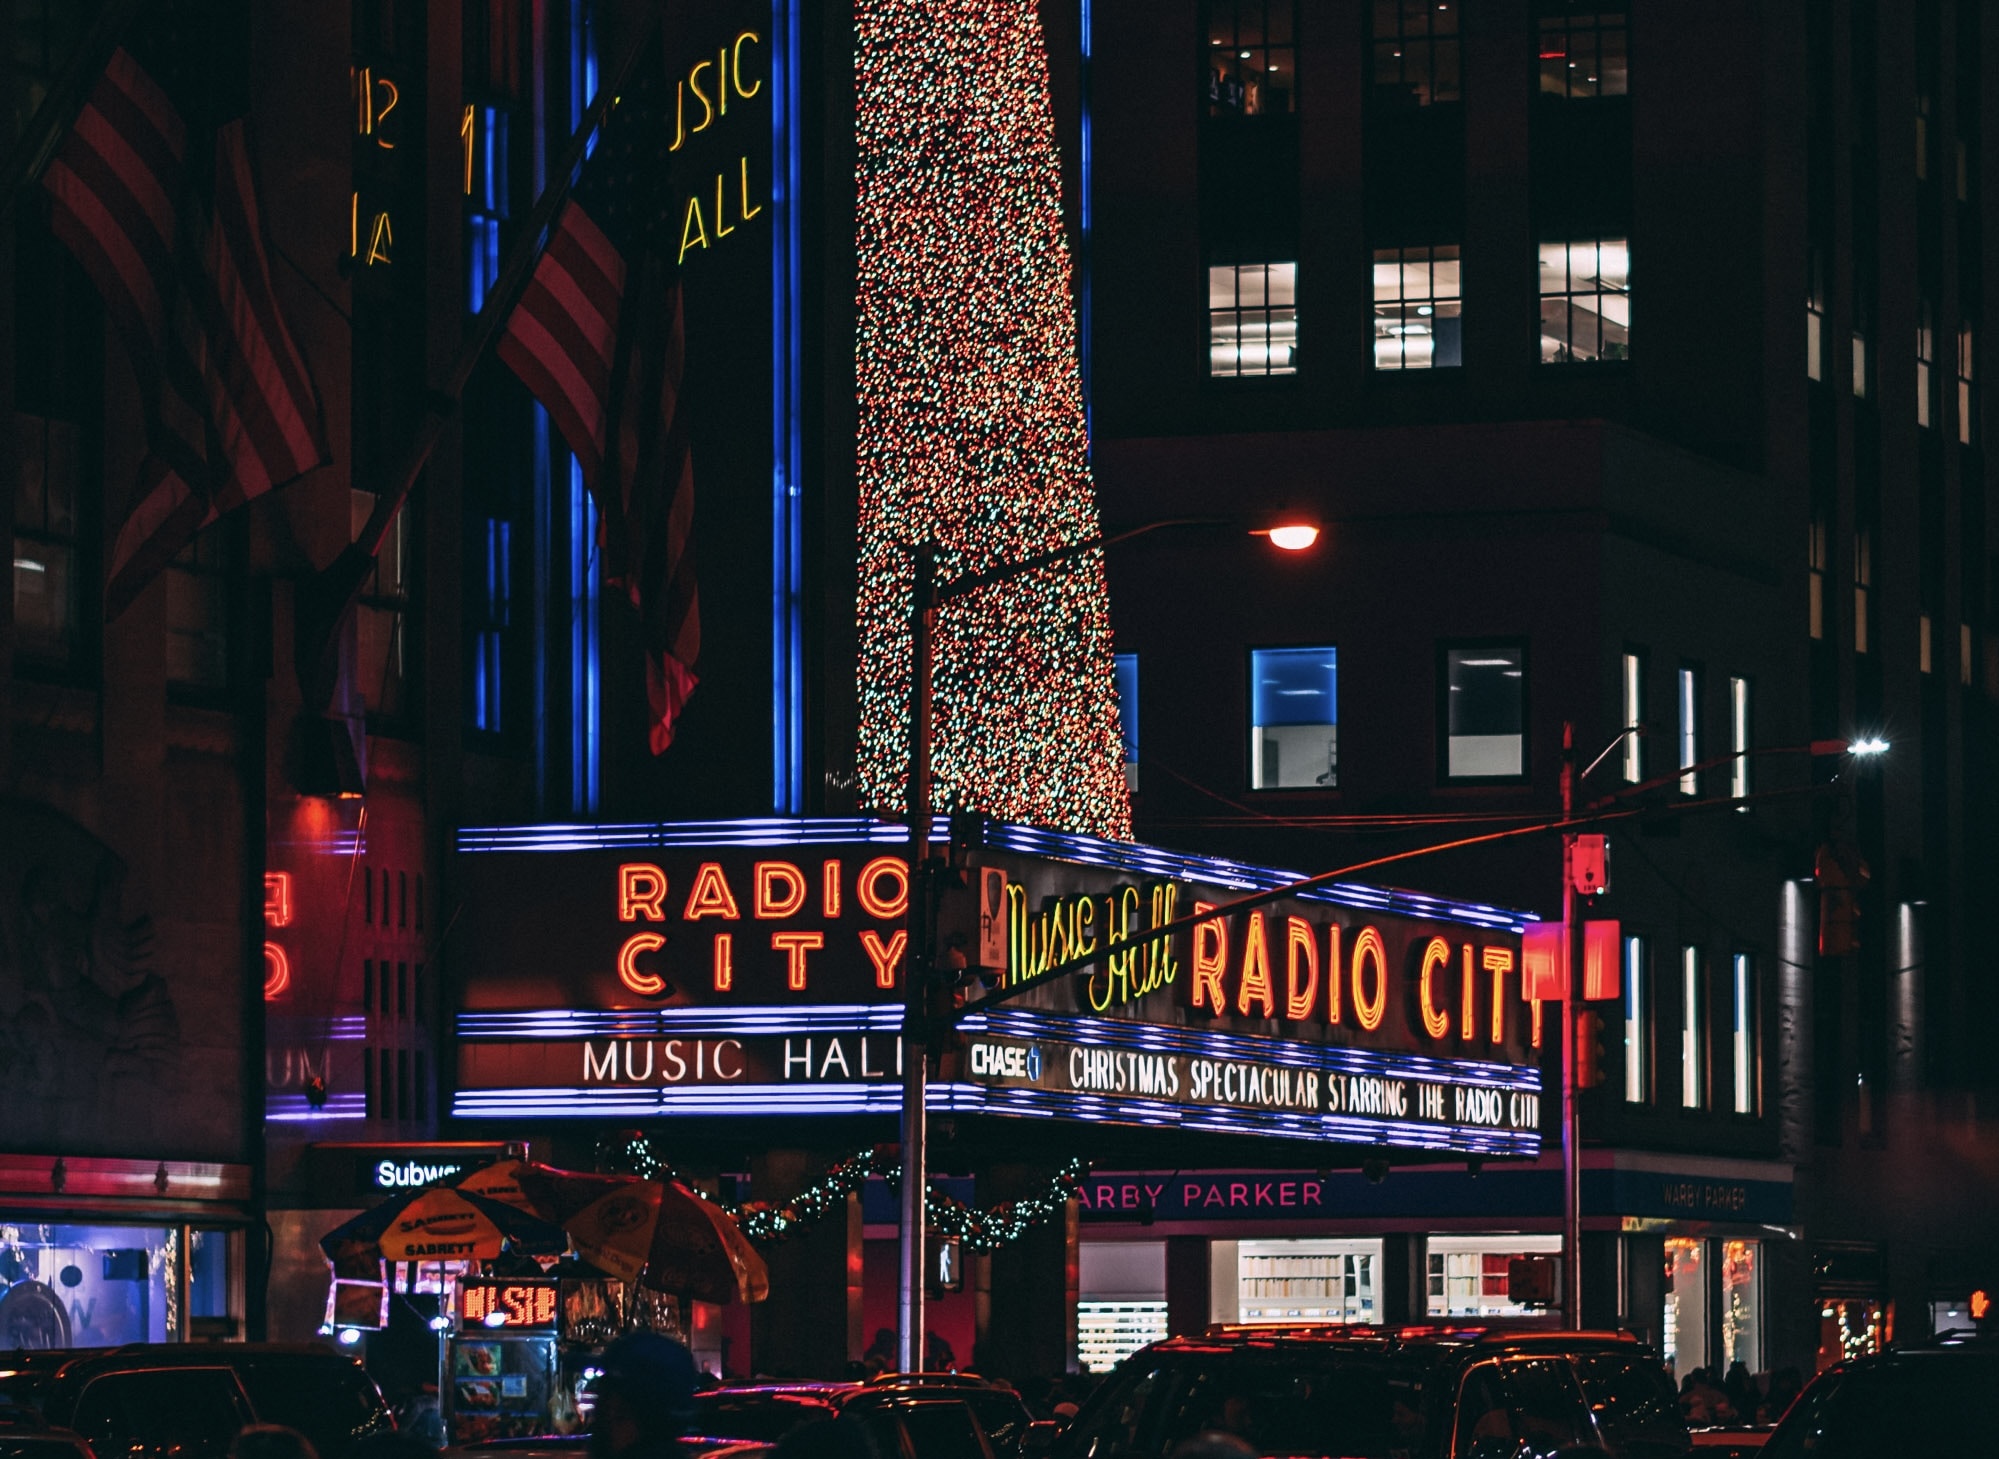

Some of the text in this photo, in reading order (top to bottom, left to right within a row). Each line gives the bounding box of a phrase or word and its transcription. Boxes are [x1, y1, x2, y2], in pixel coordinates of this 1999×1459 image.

[677, 156, 762, 266] ALL
[618, 856, 909, 922] RADIO
[617, 930, 907, 995] CITY
[1193, 900, 1387, 1032] RADIO
[583, 1037, 743, 1082] MUSIC
[971, 1042, 1027, 1078] CHASE
[1069, 1046, 1180, 1097] CHRISTMAS
[1190, 1058, 1319, 1109] SPECTACULAR
[1328, 1073, 1407, 1117] STARRING
[1416, 1081, 1447, 1121] THE
[1456, 1086, 1502, 1126] RADIO
[378, 1159, 461, 1188] Subw
[1076, 1182, 1322, 1209] ARBY PARKER
[1663, 1183, 1746, 1211] WARBY PARKER
[405, 1242, 475, 1257] SABRETT
